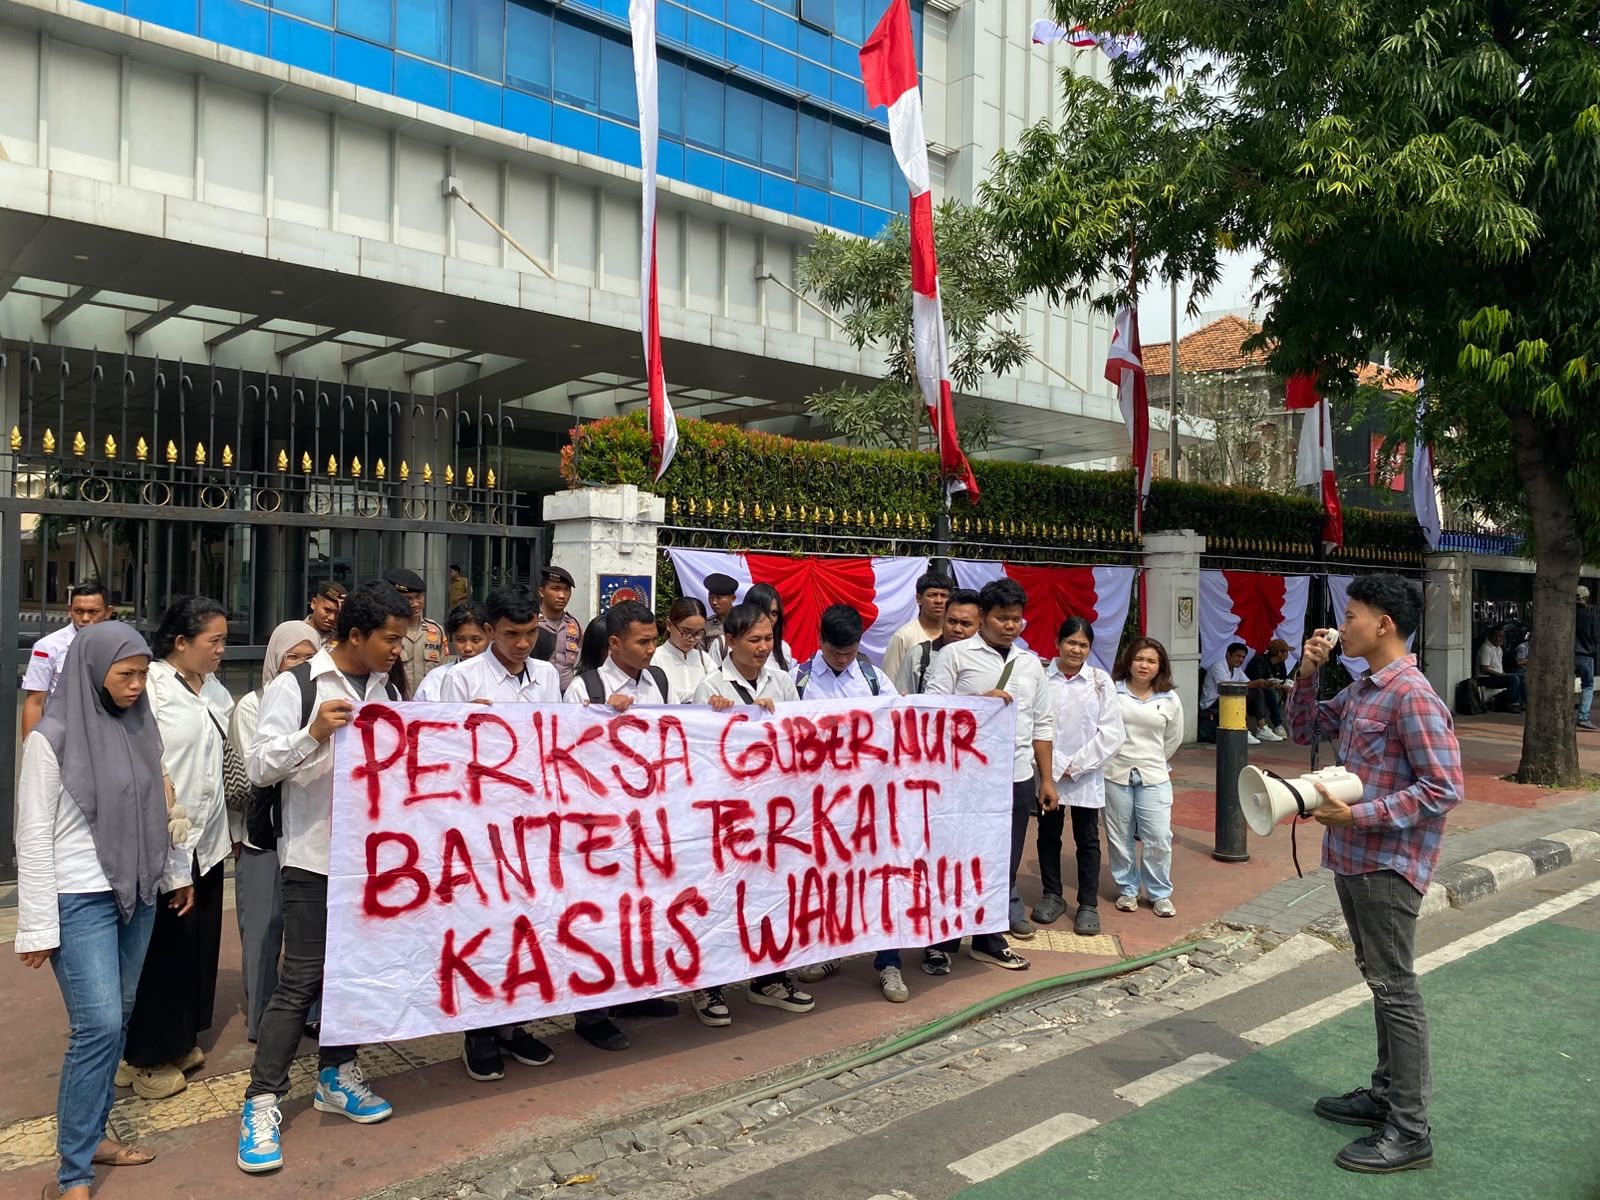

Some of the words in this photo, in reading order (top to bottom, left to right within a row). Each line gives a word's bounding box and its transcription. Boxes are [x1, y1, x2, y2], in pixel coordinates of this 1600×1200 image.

[353, 704, 693, 820] PERIKSA
[720, 706, 988, 780] GUBERNUR
[363, 807, 675, 917] BANTEN
[691, 779, 941, 872] TERKAIT
[439, 886, 709, 1016] KASUS
[735, 855, 985, 964] WANITA!!!
